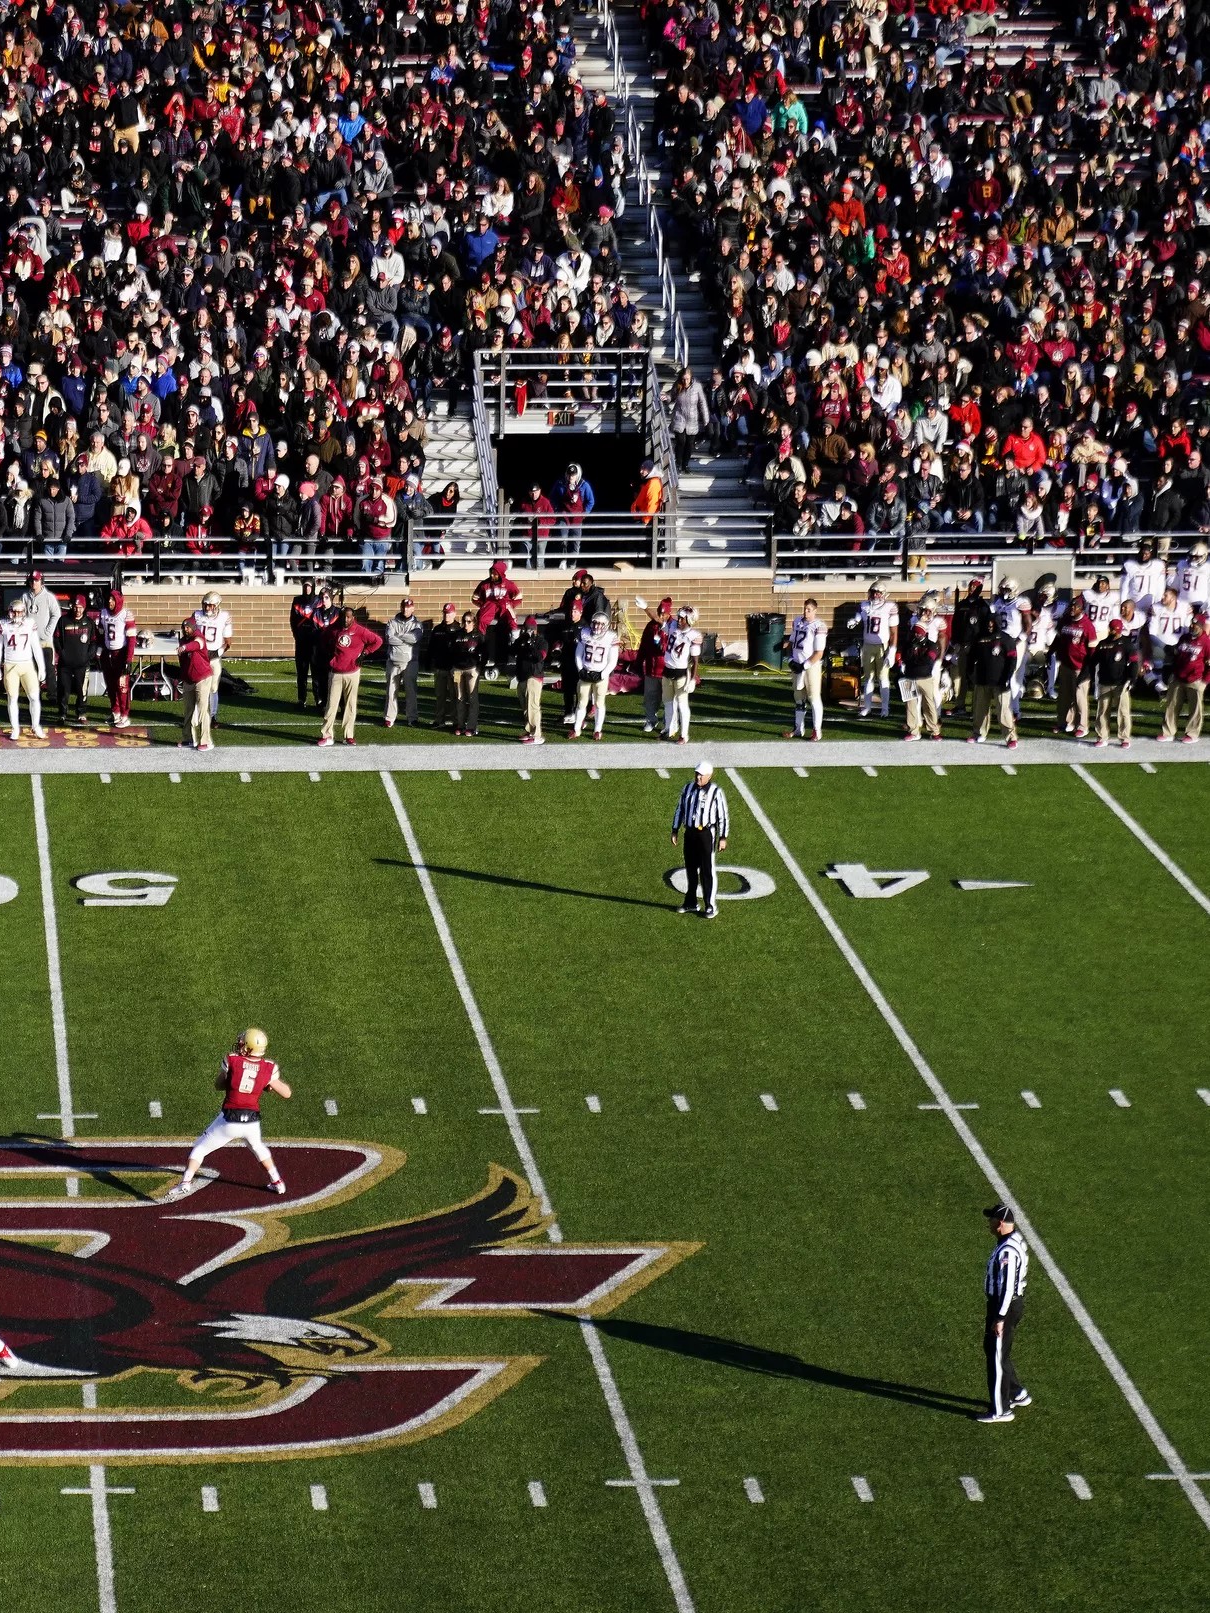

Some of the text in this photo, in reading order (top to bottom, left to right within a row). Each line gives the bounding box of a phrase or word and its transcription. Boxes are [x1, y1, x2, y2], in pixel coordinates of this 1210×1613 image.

[553, 412, 572, 425] EXIT
[1135, 574, 1152, 593] 71
[1182, 572, 1200, 592] 51
[1088, 604, 1110, 622] 88
[202, 626, 218, 643] 13
[865, 615, 882, 635] 18
[1159, 616, 1182, 635] 70
[7, 633, 30, 651] 47
[793, 629, 808, 651] 12
[584, 644, 606, 664] 63
[238, 1068, 258, 1094] 6
